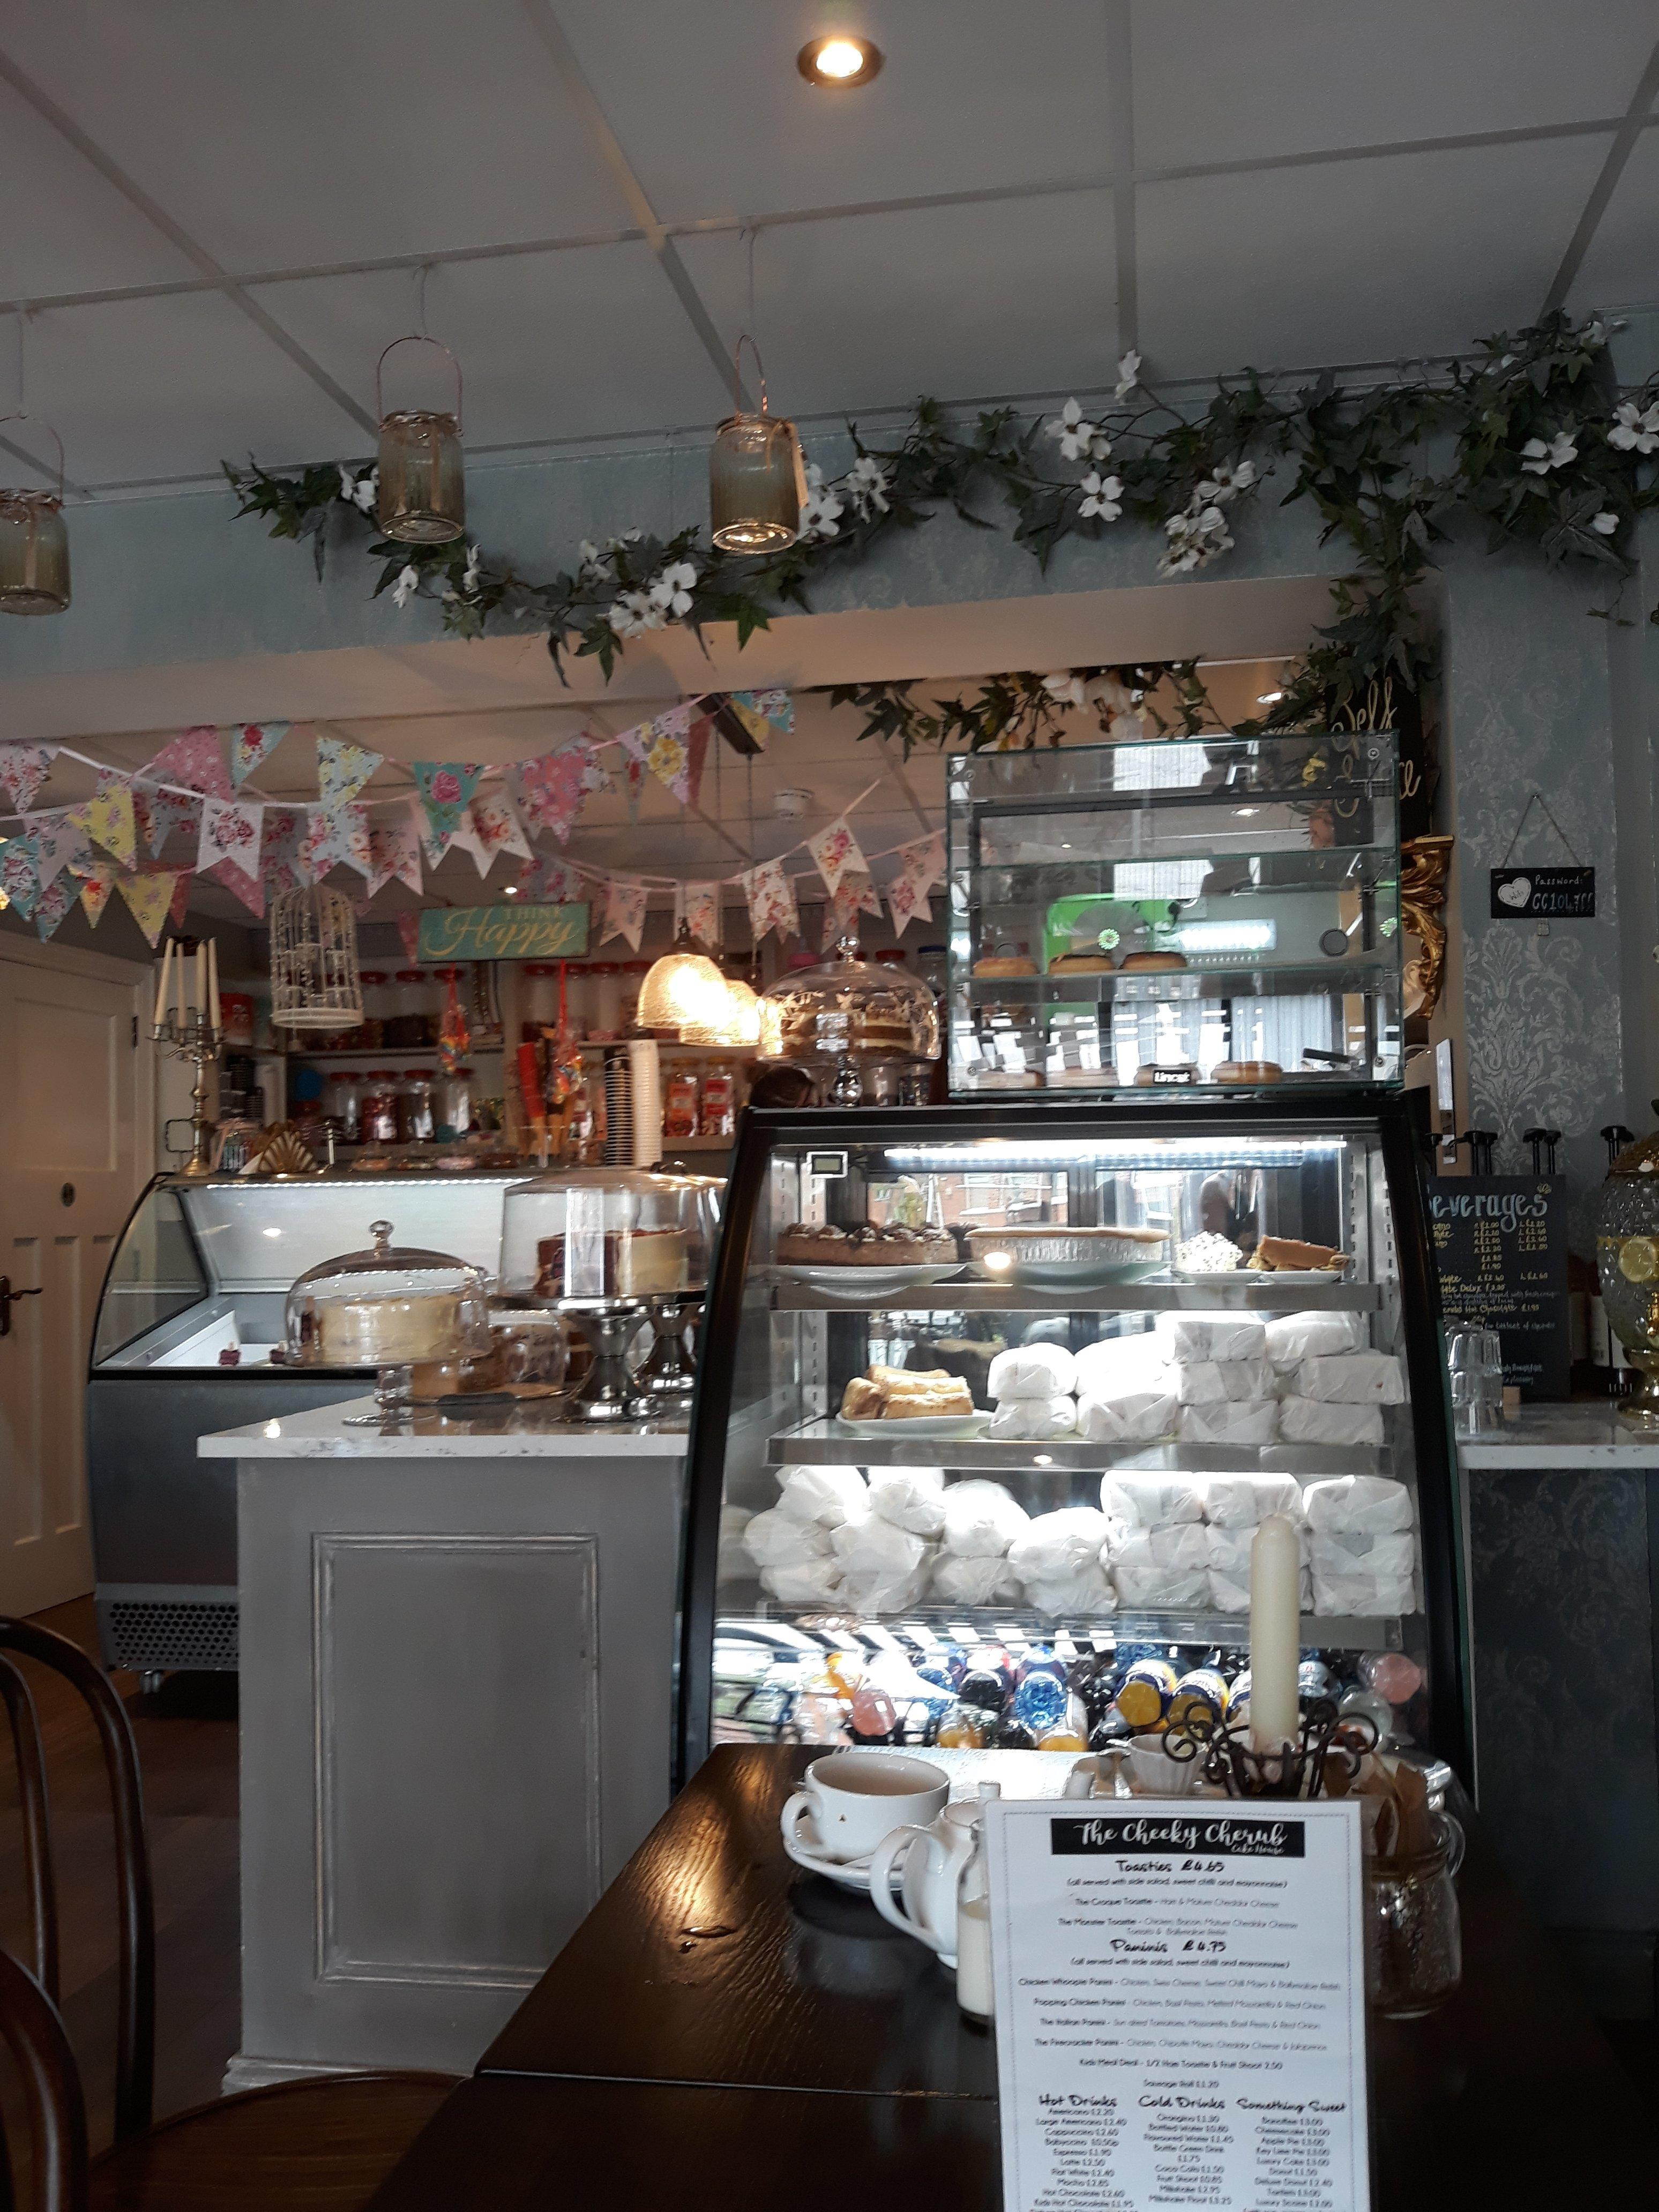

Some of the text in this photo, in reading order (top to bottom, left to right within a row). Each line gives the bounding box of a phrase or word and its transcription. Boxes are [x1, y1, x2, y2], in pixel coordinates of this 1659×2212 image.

[425, 907, 574, 957] Happy
[1429, 1193, 1548, 1232] everages
[1073, 1819, 1288, 1850] The Cheeky Cherub
[1115, 1859, 1172, 1872] Toasties
[1110, 1939, 1168, 1952] Paninis
[1038, 2093, 1117, 2107] Hot Drinks
[1138, 2095, 1225, 2109] Cold Drinks
[1235, 2098, 1347, 2114] Something Sweet
